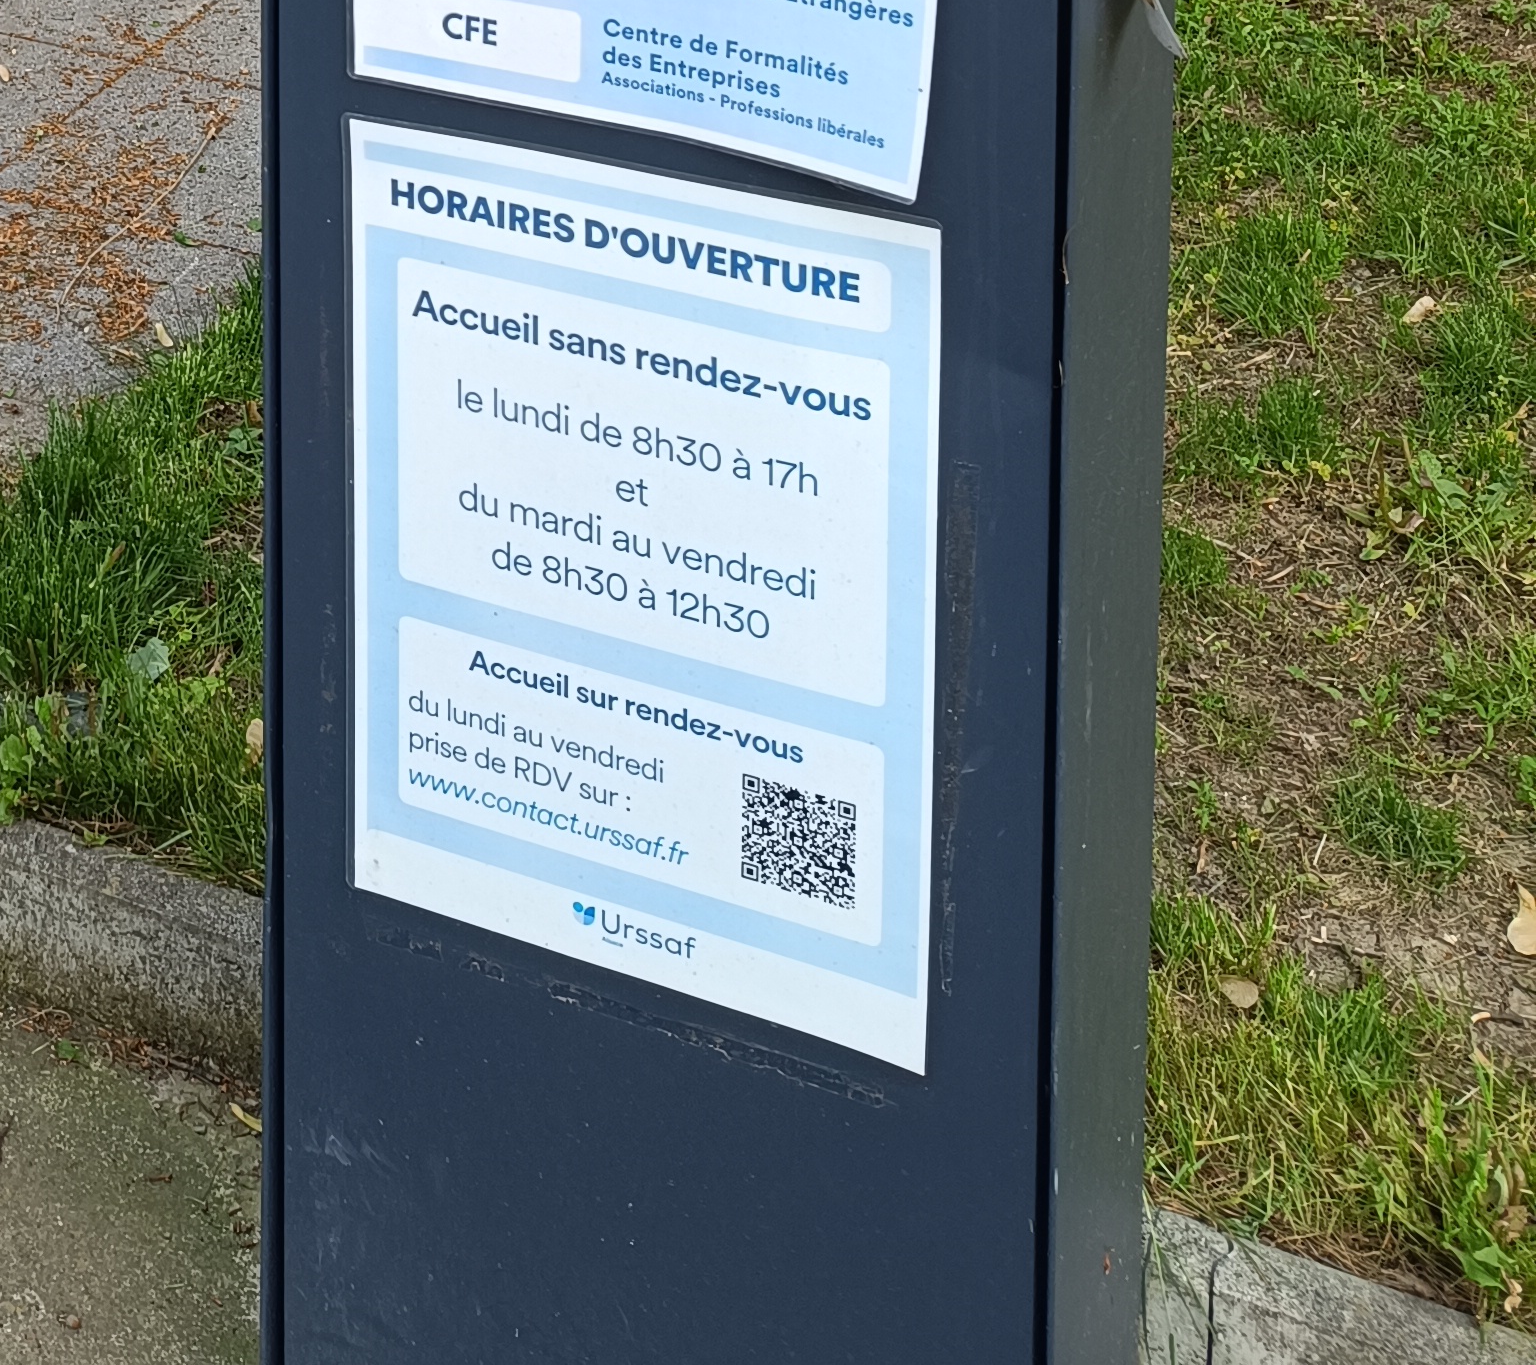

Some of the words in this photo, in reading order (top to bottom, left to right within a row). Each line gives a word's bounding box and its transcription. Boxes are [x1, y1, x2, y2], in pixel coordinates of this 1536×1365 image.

[442, 13, 497, 46] CFE
[603, 46, 641, 69] des
[649, 55, 781, 99] Entreprises
[604, 19, 682, 48] Centre
[690, 34, 717, 55] de
[725, 40, 849, 86] Formalités
[601, 71, 705, 103] Associations
[721, 94, 812, 129] Professions
[818, 117, 884, 148] libérales
[391, 179, 574, 242] HORAIRES
[585, 218, 859, 303] D'OUVERTURE
[412, 290, 538, 345] Accueil
[549, 329, 625, 365] sans
[636, 348, 871, 420] rendez-vous
[458, 379, 483, 413] le
[494, 388, 569, 435] lundi
[581, 413, 622, 447] de
[633, 426, 721, 472] 8h30
[733, 448, 750, 480] à
[762, 458, 817, 496] 17h
[616, 479, 648, 507] et
[459, 483, 498, 518] du
[509, 496, 602, 545] mardi
[613, 531, 650, 558] au
[662, 542, 815, 600] vendredi
[492, 542, 532, 576] de
[543, 556, 627, 601] 8h30
[639, 579, 655, 610] à
[666, 589, 769, 638] 12h30
[409, 690, 438, 717] du
[448, 699, 505, 737] lundi
[514, 726, 542, 748] au
[551, 736, 663, 783] vendredi
[469, 651, 568, 698] Accueil
[577, 687, 618, 710] sur
[626, 699, 803, 763] rendez-vous
[410, 732, 467, 762] prise
[475, 747, 506, 774] de
[515, 756, 572, 792] RDV
[579, 783, 618, 806] sur
[408, 767, 690, 866] www.contact.urssaf.fr
[602, 909, 696, 959] Urssaf
